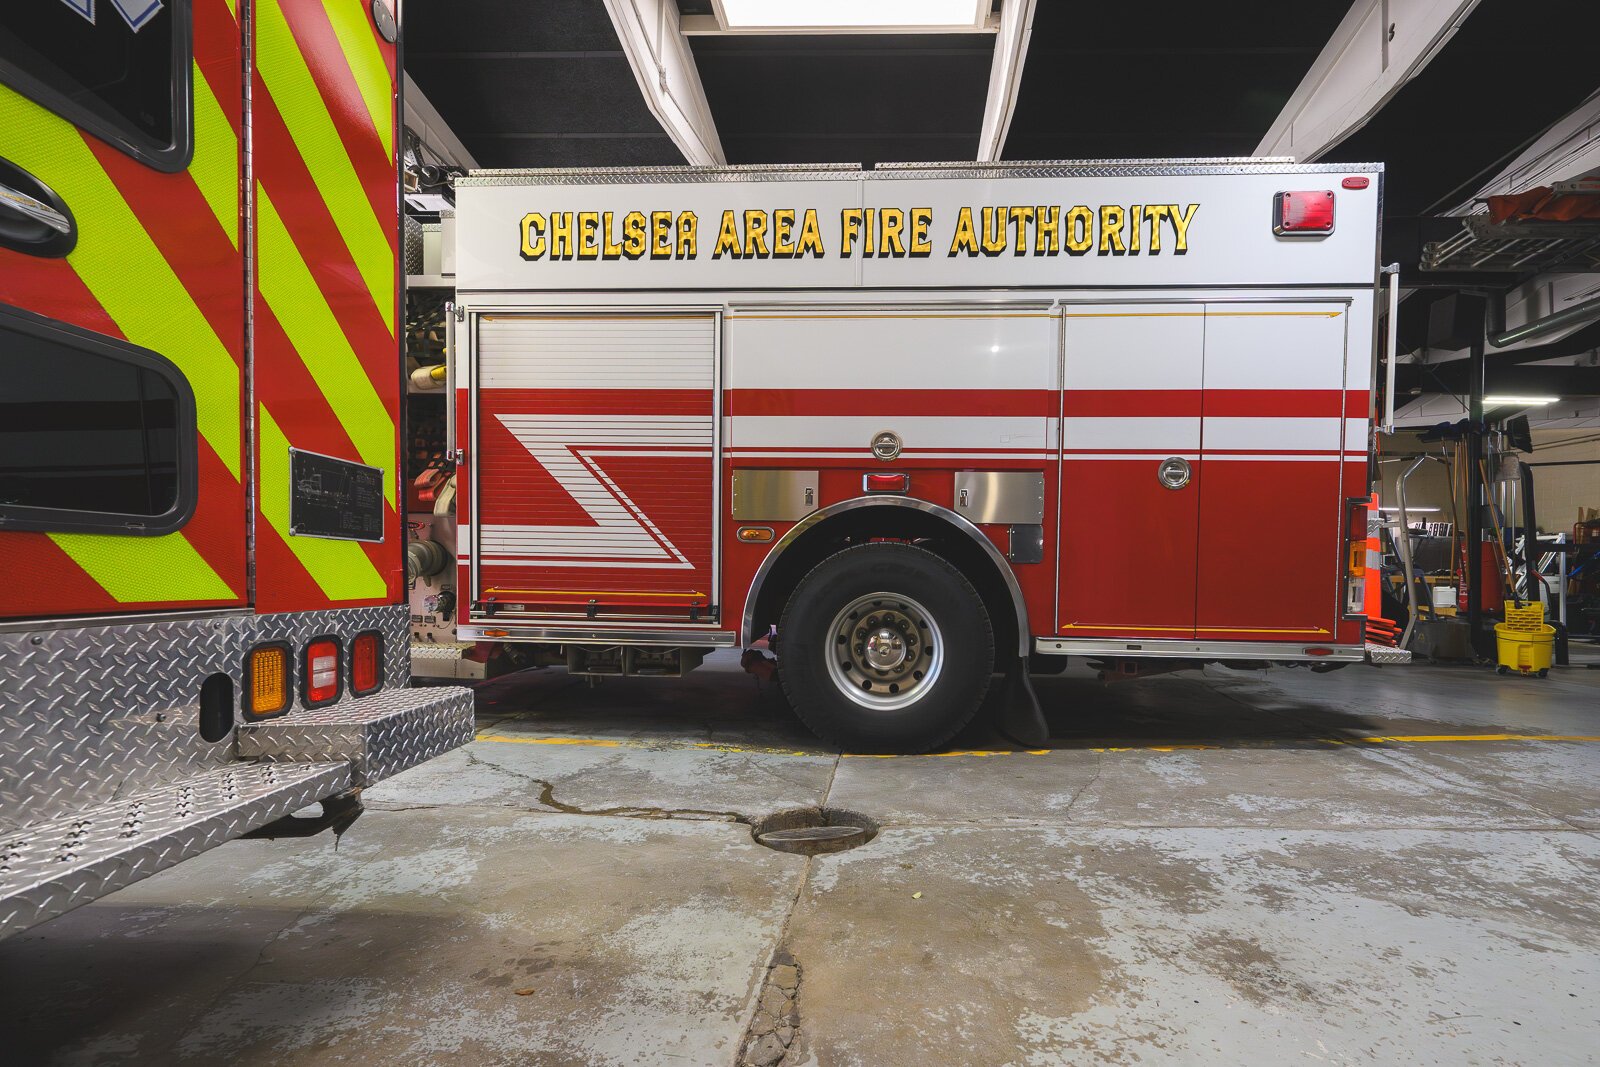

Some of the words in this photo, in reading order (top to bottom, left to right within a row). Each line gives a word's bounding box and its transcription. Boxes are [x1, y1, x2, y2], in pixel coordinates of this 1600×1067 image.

[519, 211, 698, 261] CHELSEA
[711, 209, 825, 260] AREA
[840, 208, 932, 259] FIRE
[947, 204, 1200, 258] AUTHORITY
